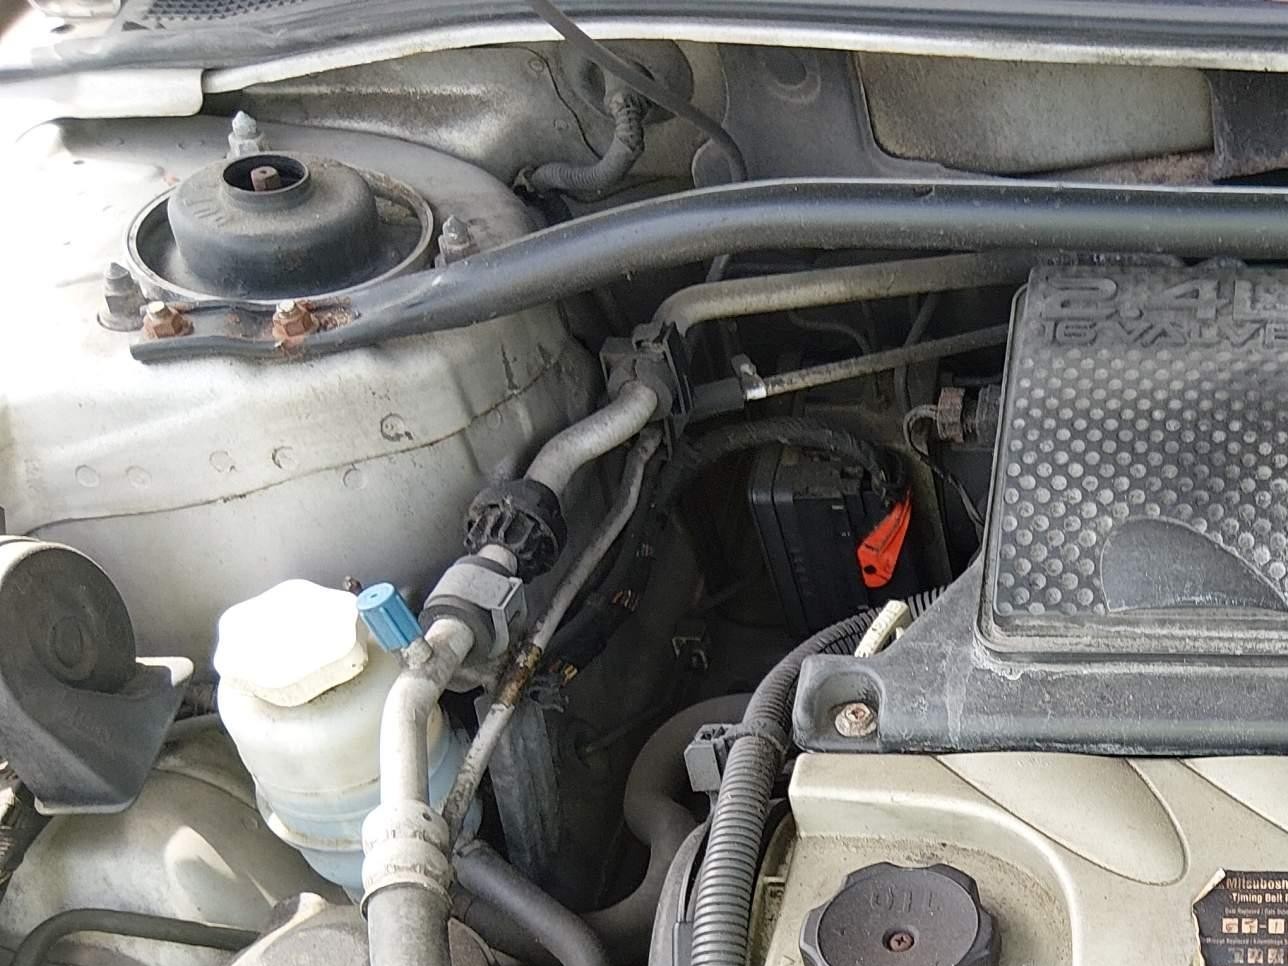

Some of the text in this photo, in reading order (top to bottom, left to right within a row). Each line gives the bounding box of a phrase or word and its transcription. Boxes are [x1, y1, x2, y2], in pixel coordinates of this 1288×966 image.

[1041, 320, 1098, 347] 16
[1231, 893, 1263, 904] Timing
[1265, 892, 1283, 903] Belt
